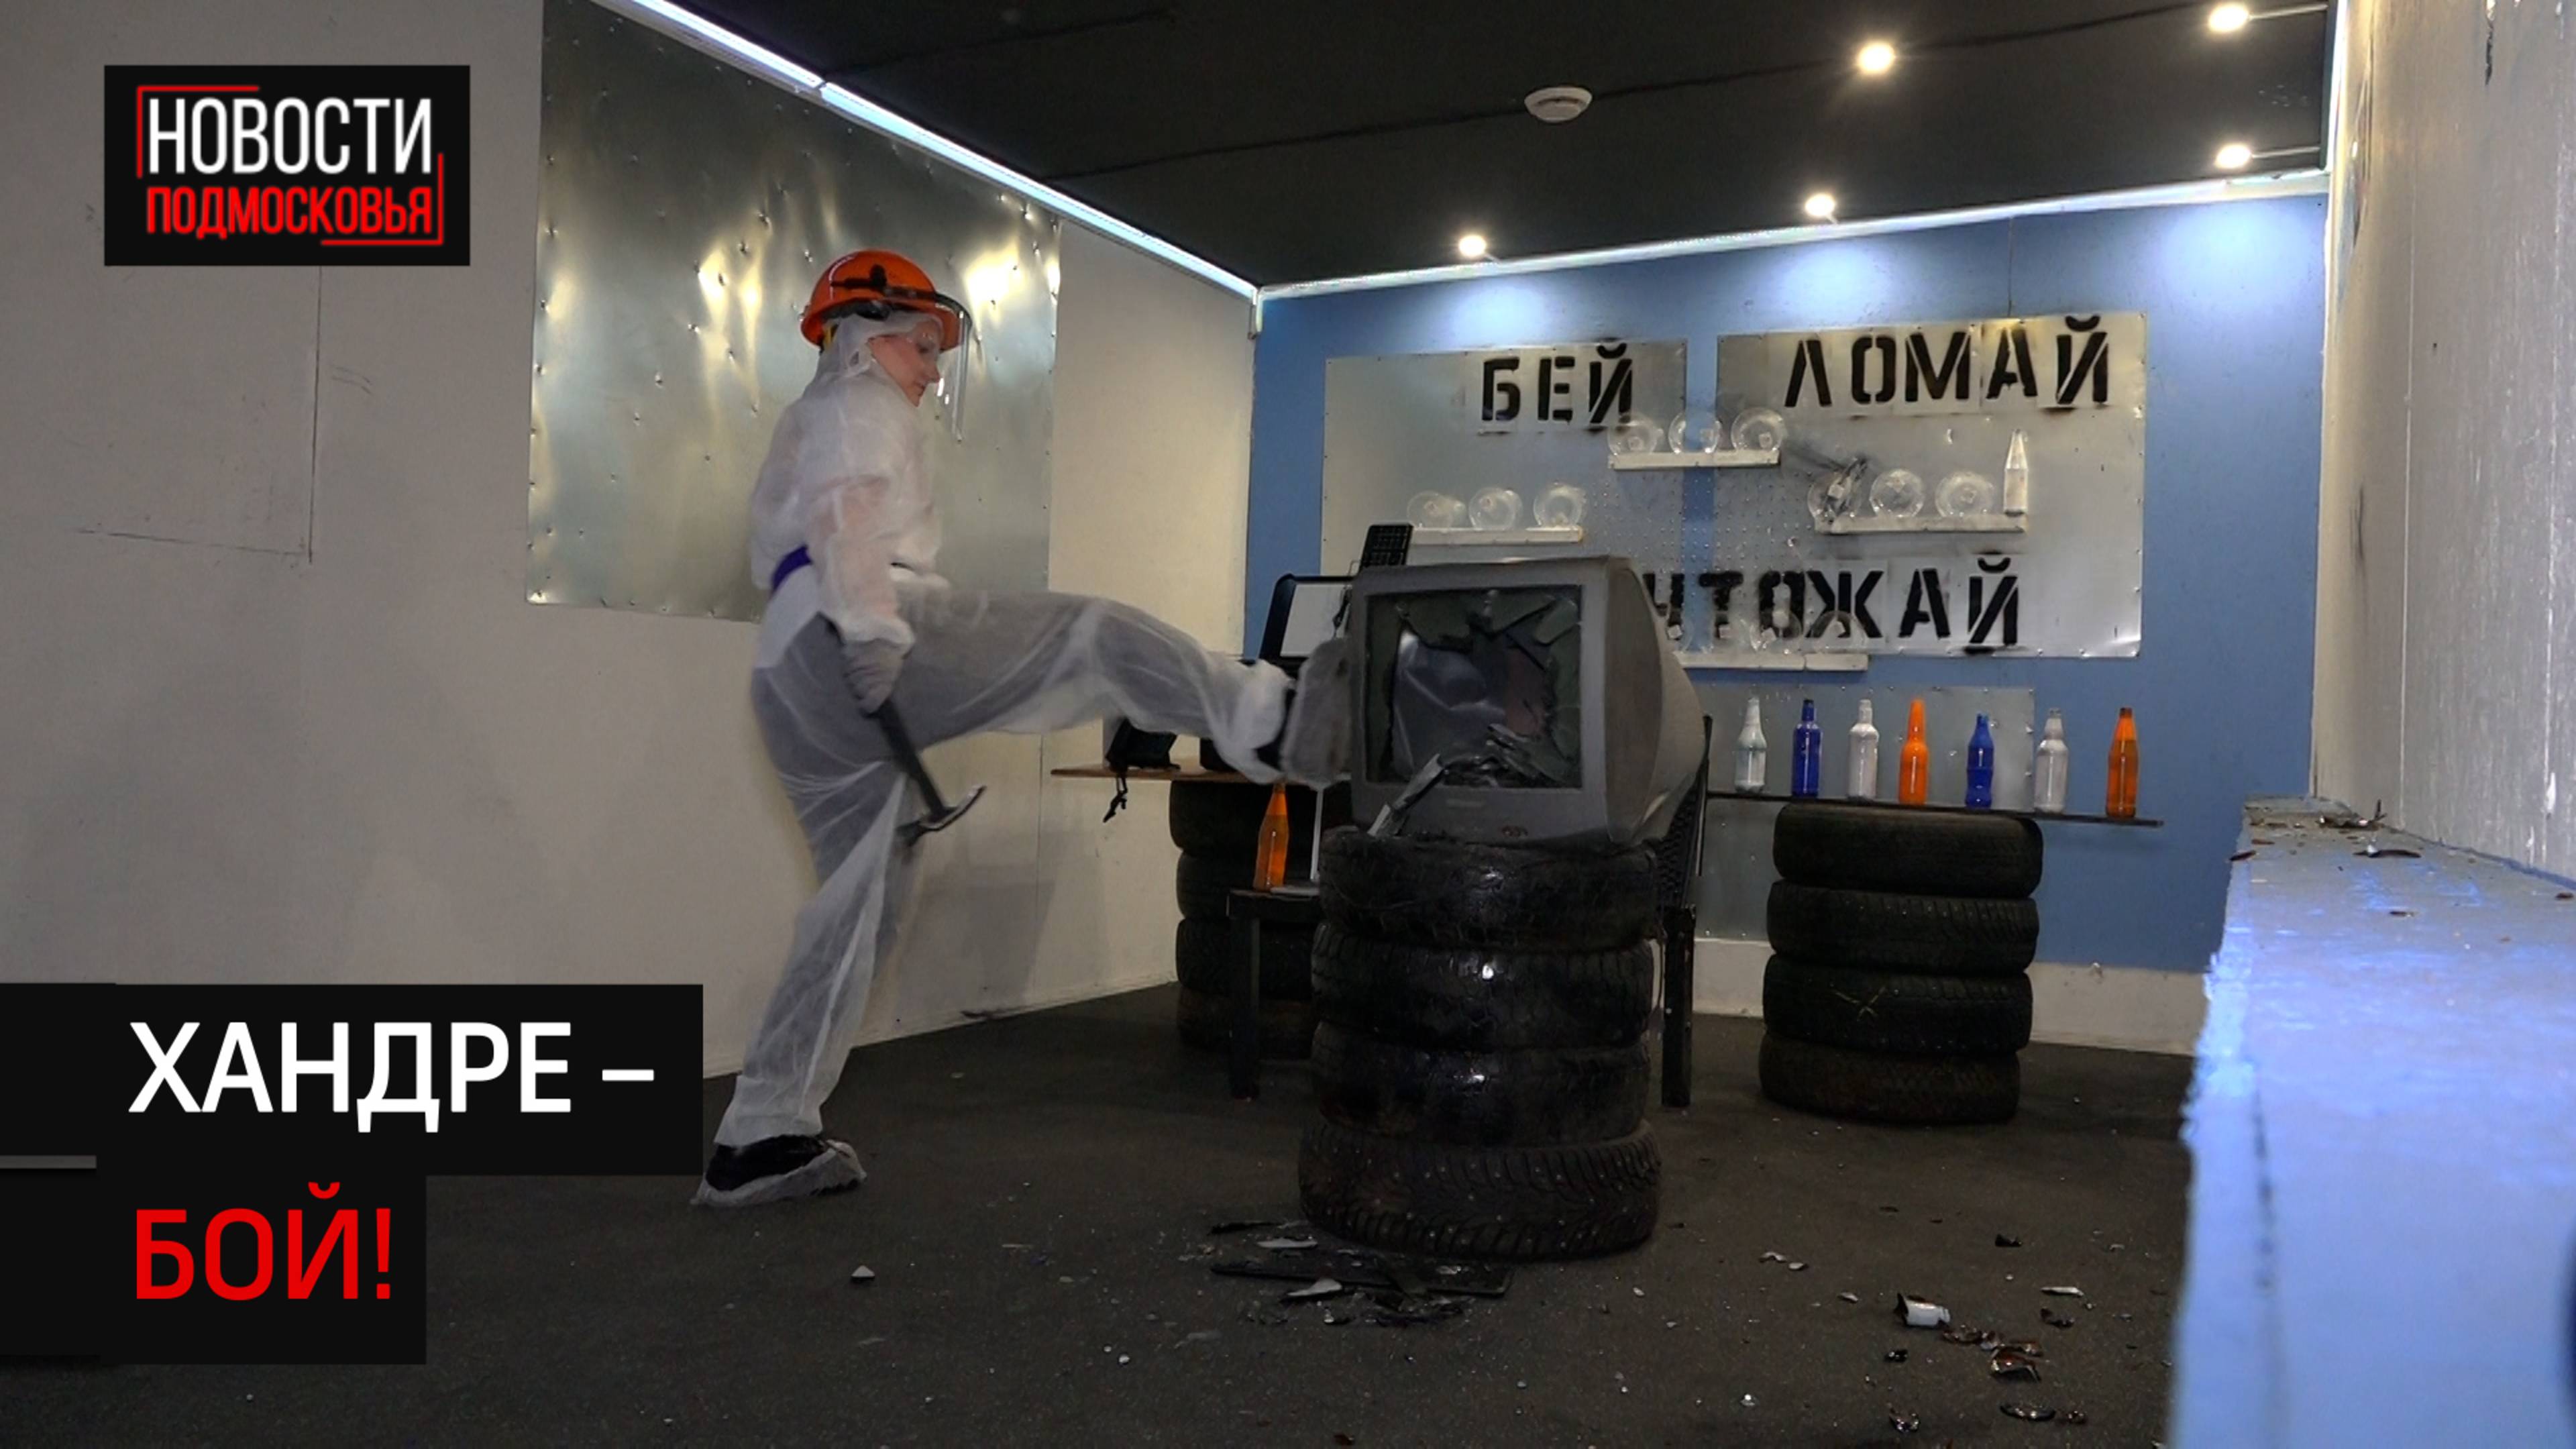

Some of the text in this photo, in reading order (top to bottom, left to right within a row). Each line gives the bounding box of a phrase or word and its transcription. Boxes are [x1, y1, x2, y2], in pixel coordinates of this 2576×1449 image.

[1481, 315, 2109, 425] БЕЙ ЛОМАЙ
[1642, 557, 2019, 646] ЧТОЖАЙ
